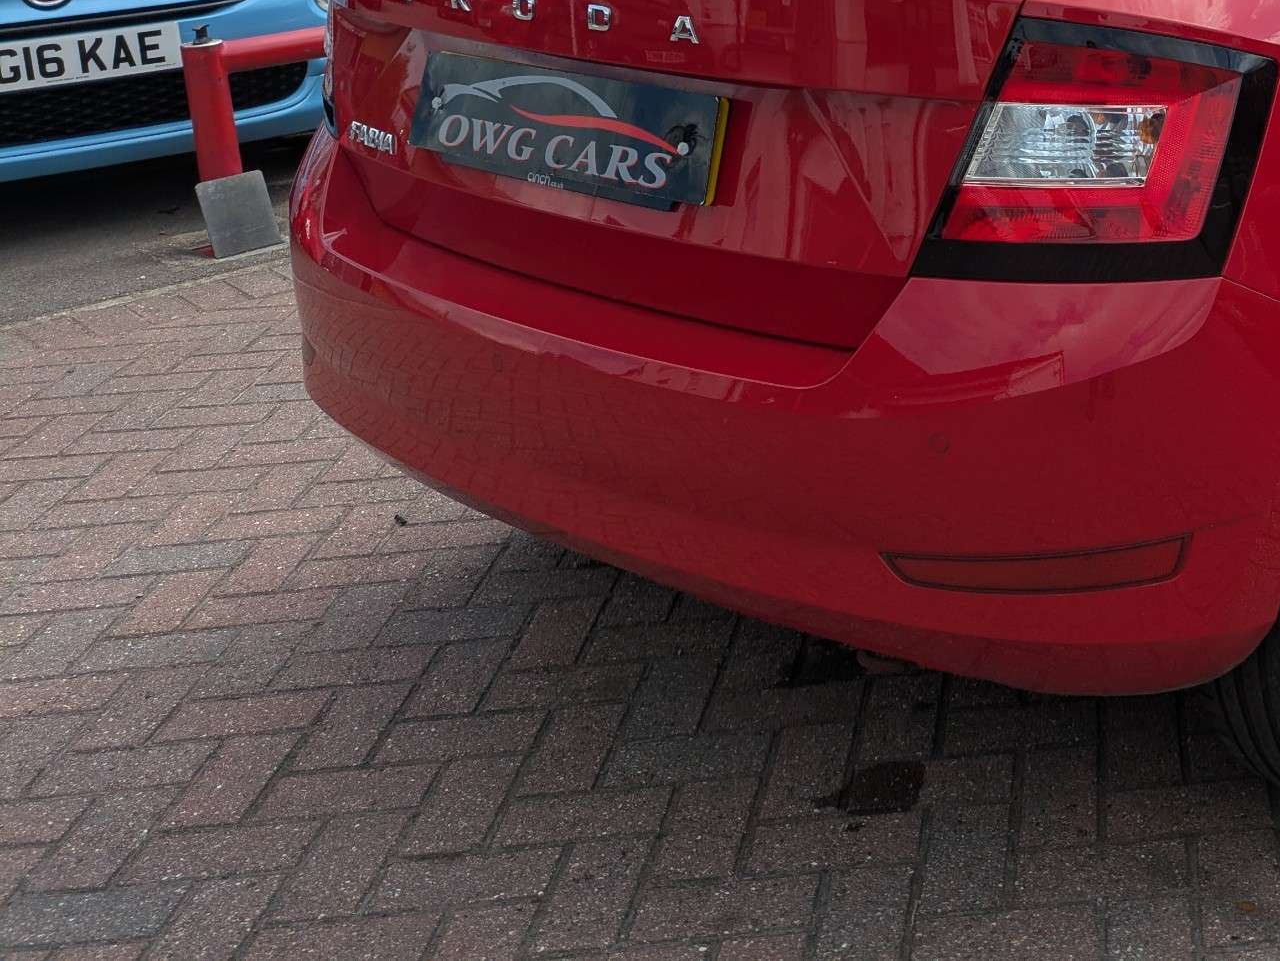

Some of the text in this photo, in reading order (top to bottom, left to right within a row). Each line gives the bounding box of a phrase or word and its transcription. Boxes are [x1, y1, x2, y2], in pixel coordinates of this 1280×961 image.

[77, 29, 166, 74] KAE
[350, 120, 394, 155] FABIA
[437, 114, 673, 190] OWG CARS
